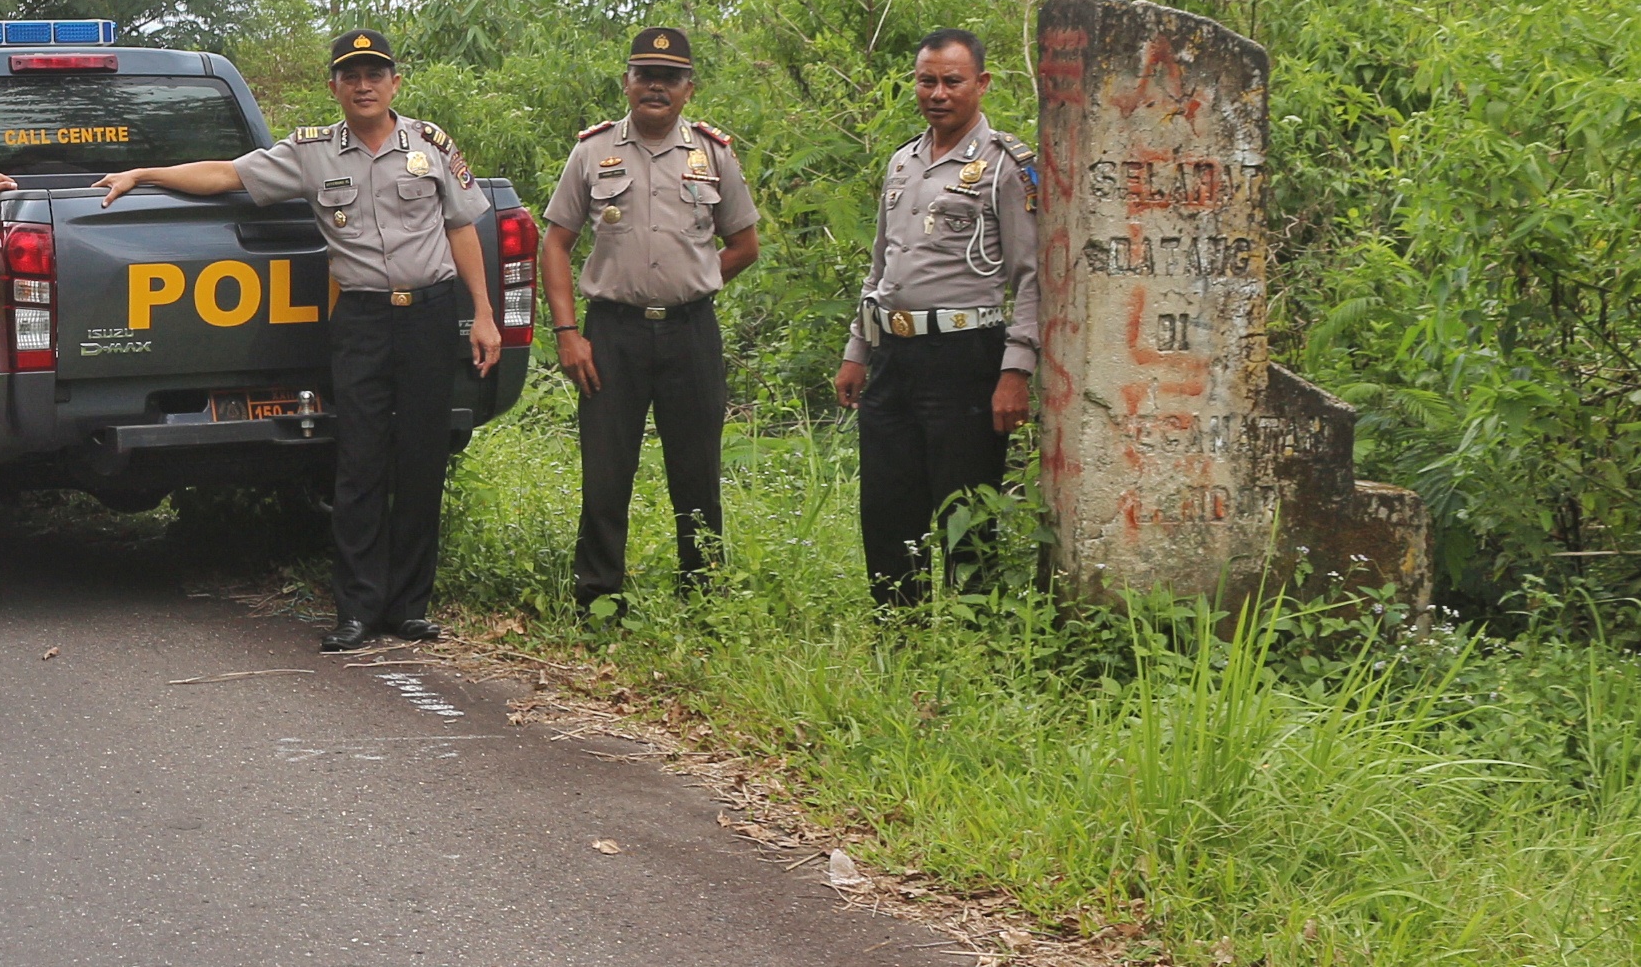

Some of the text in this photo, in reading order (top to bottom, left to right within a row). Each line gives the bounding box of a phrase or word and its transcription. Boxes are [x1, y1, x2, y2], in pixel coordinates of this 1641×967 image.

[4, 126, 129, 145] CALL CENTRE
[87, 328, 135, 340] ISUZU
[1157, 312, 1190, 352] DI
[80, 341, 151, 356] D-MAX
